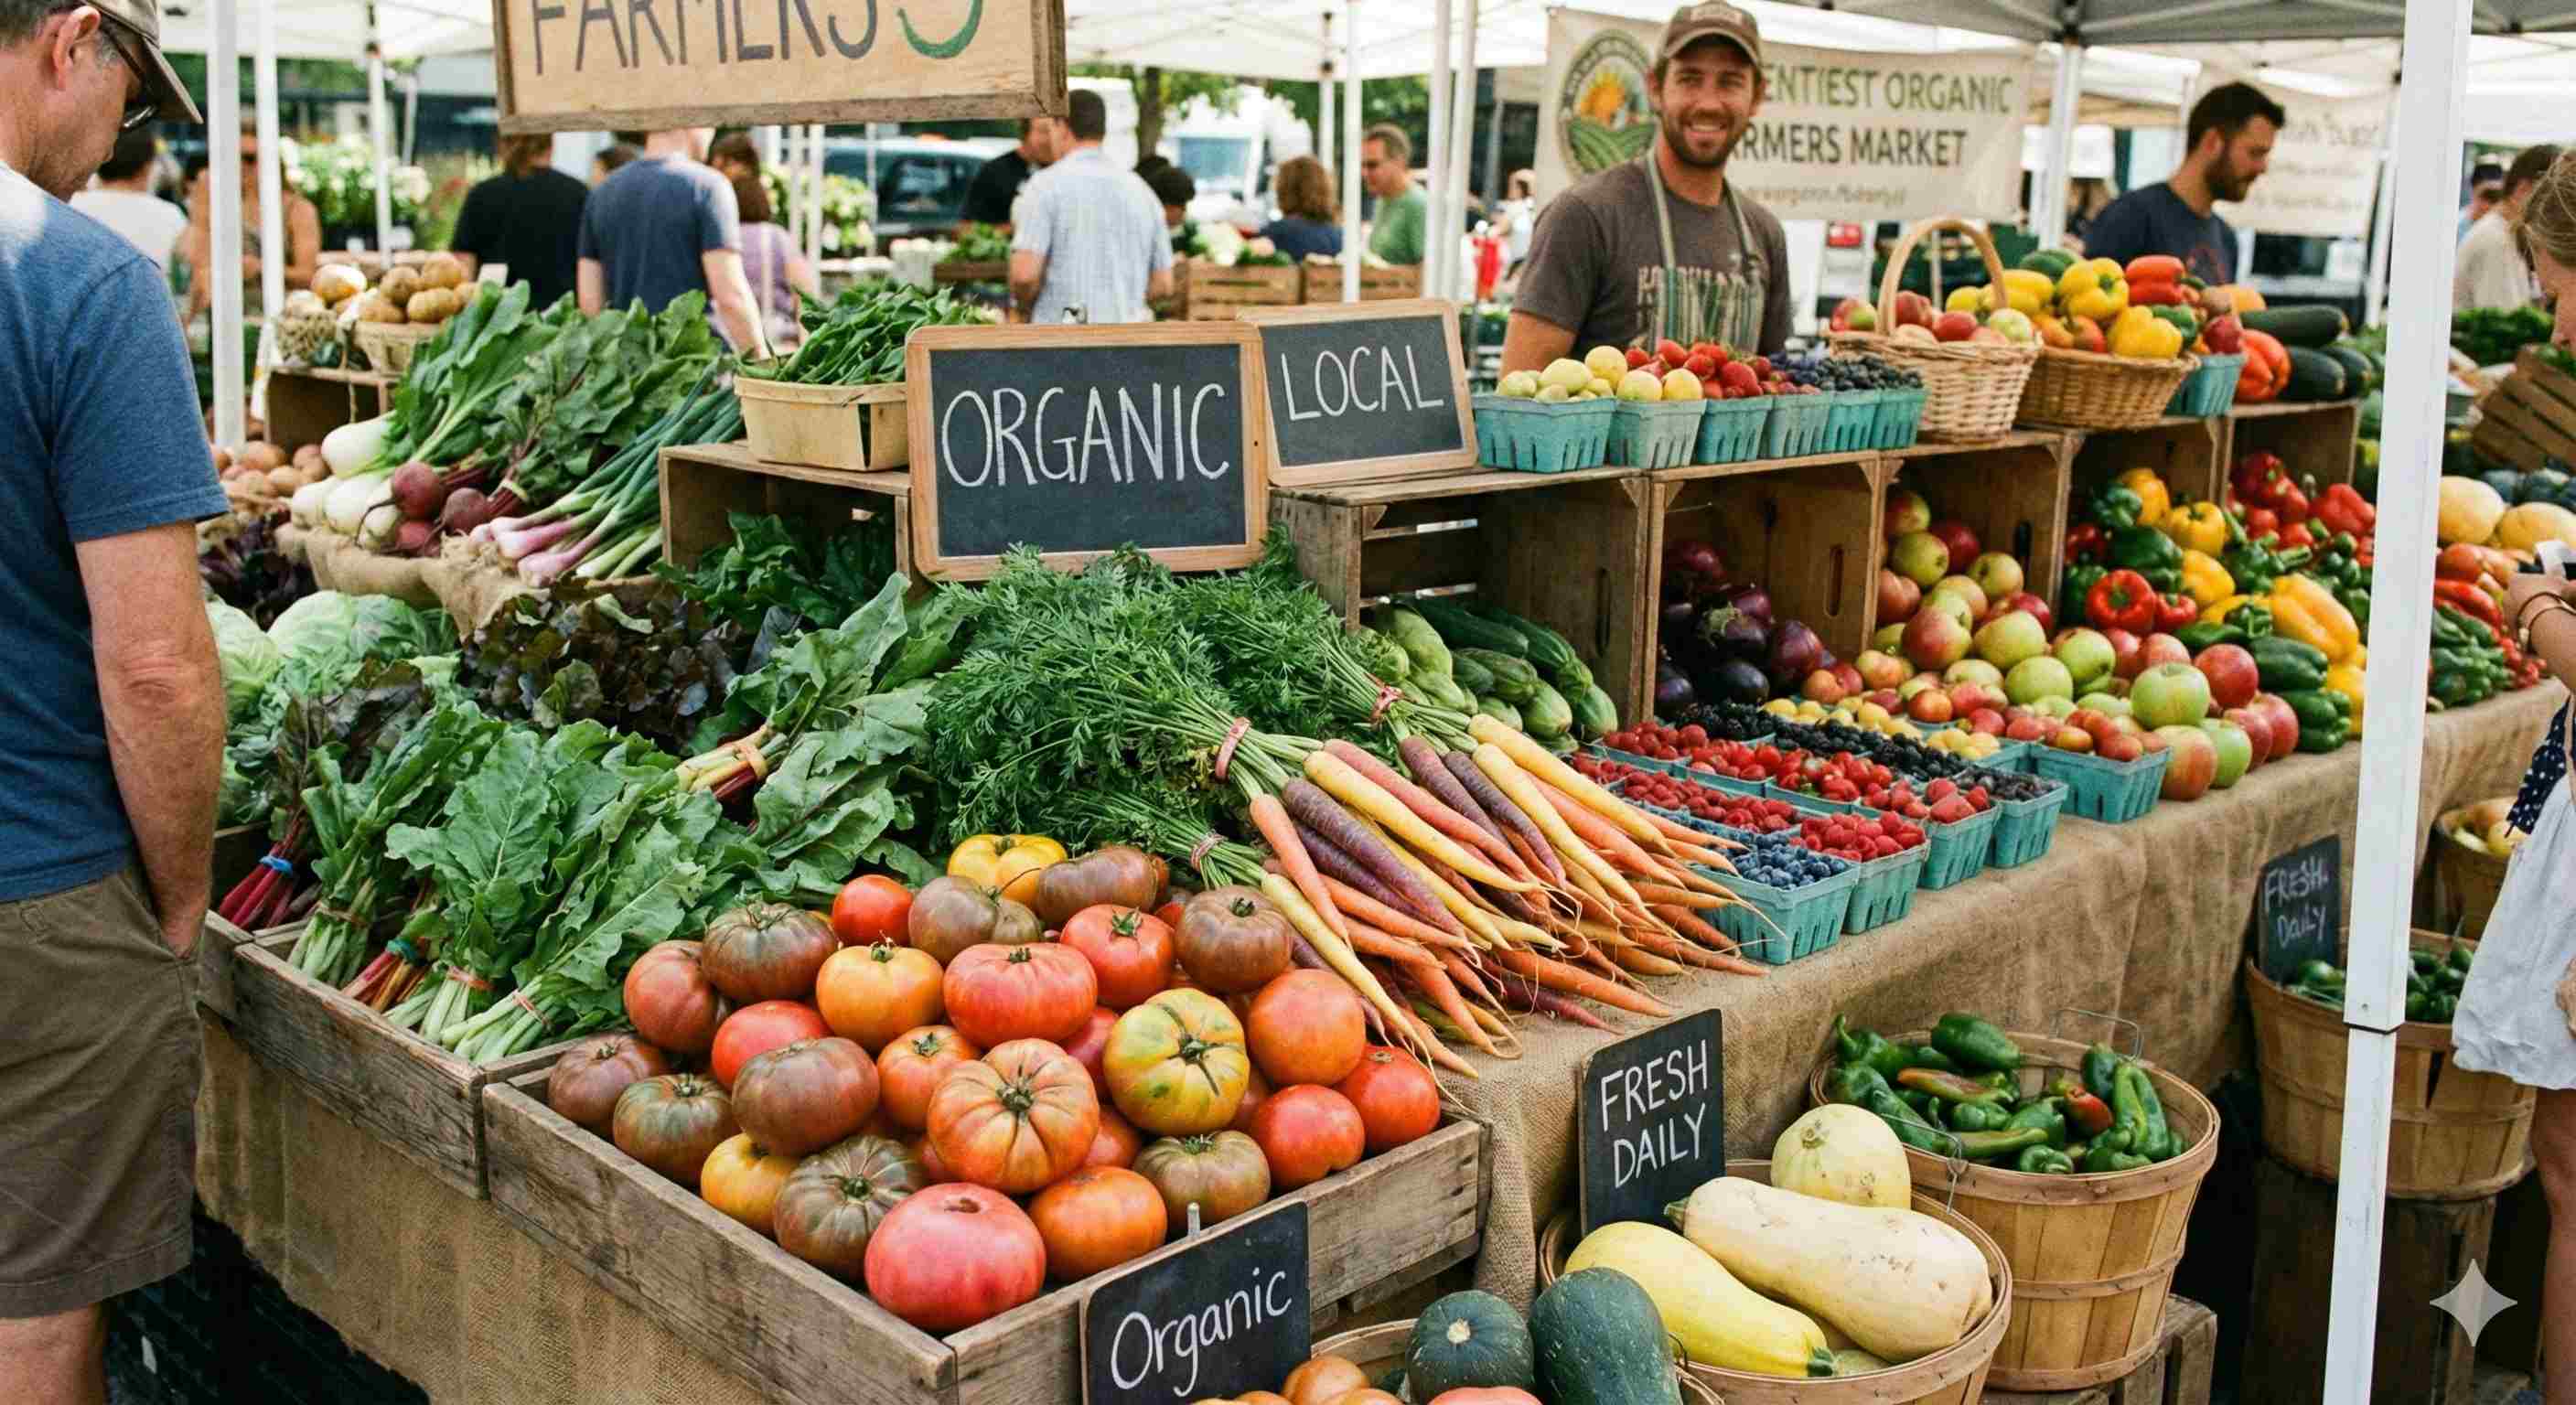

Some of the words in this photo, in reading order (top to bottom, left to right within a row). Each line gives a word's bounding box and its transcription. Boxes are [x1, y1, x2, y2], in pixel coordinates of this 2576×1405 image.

[1762, 64, 1878, 108] ENTIEST
[1884, 70, 2013, 114] ORGANIC
[1734, 121, 1841, 164] RMERS
[1850, 127, 1968, 166] MARKET
[1282, 344, 1444, 421] LOCAL
[942, 382, 1229, 488] ORGANIC
[1601, 1039, 1708, 1132] FRESH
[1613, 1102, 1706, 1188] DAILY
[1111, 1267, 1292, 1398] Organic
